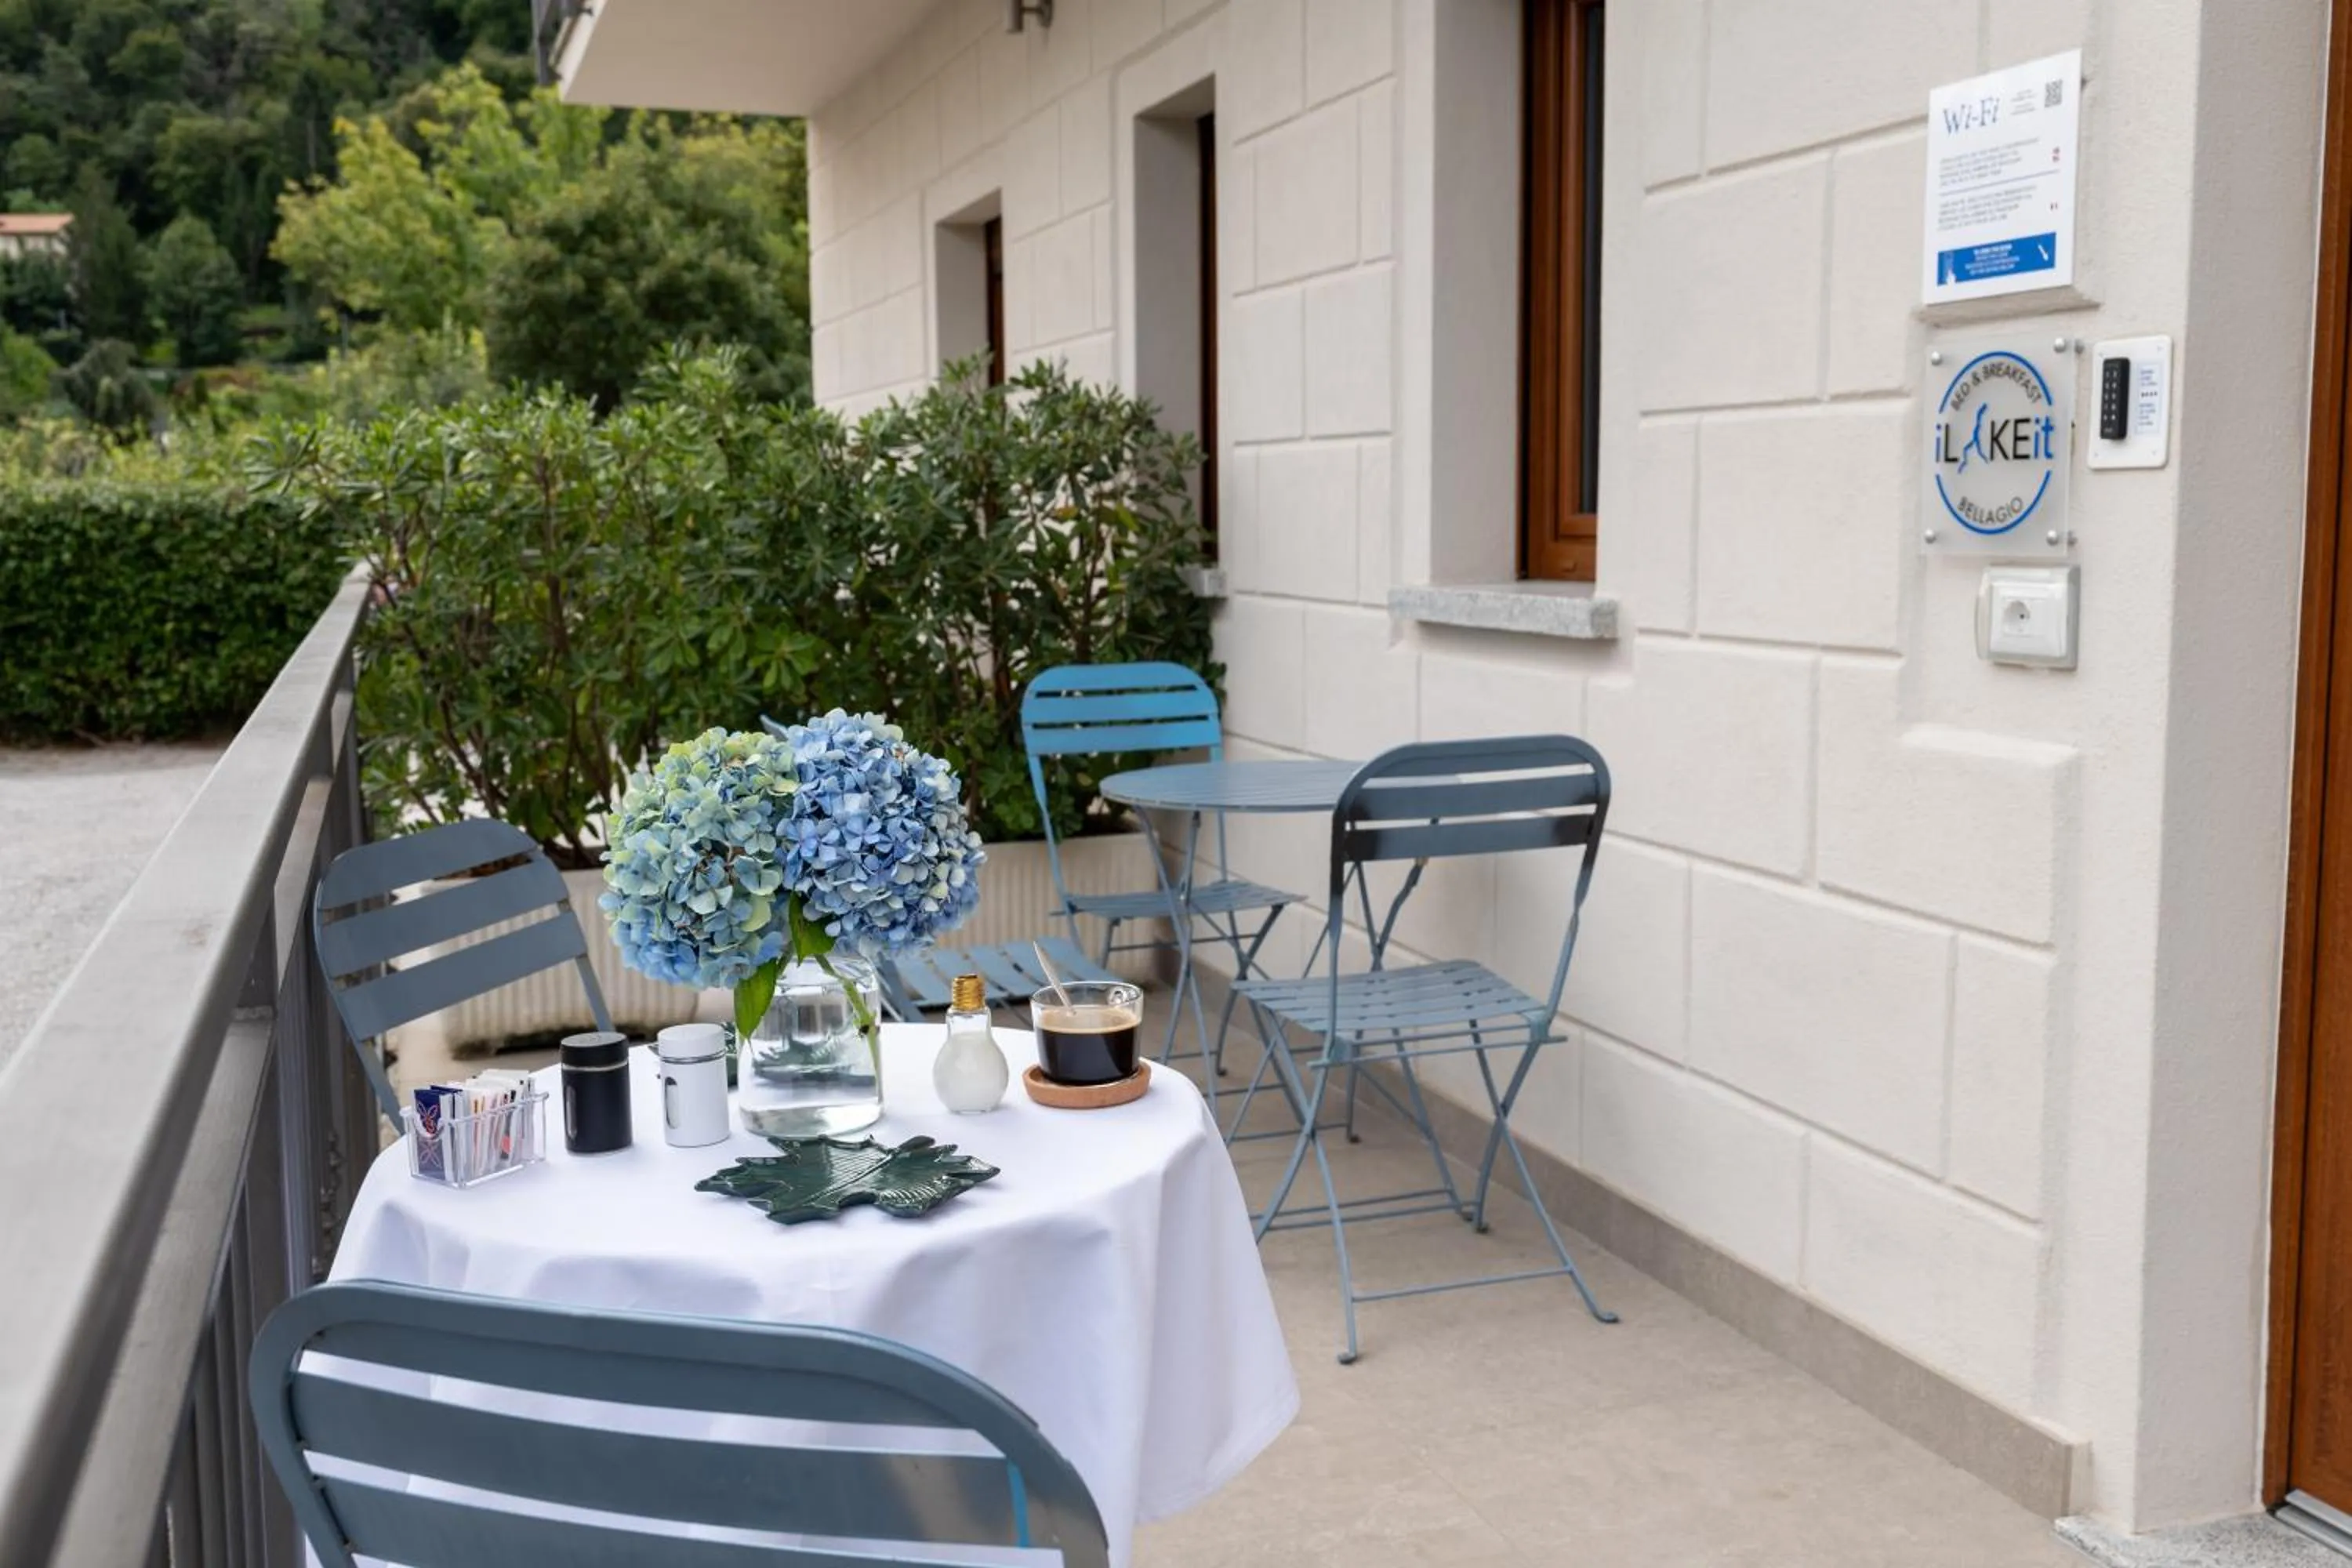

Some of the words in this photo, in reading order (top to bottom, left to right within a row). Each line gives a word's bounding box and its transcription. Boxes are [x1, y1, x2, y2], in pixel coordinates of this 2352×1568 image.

[1943, 96, 2000, 135] Wi-Fi
[1951, 383, 1971, 412] BED
[1971, 370, 1982, 387] &
[1981, 361, 2042, 404] BREAKFAST
[1957, 495, 2024, 525] BELLAGIO
